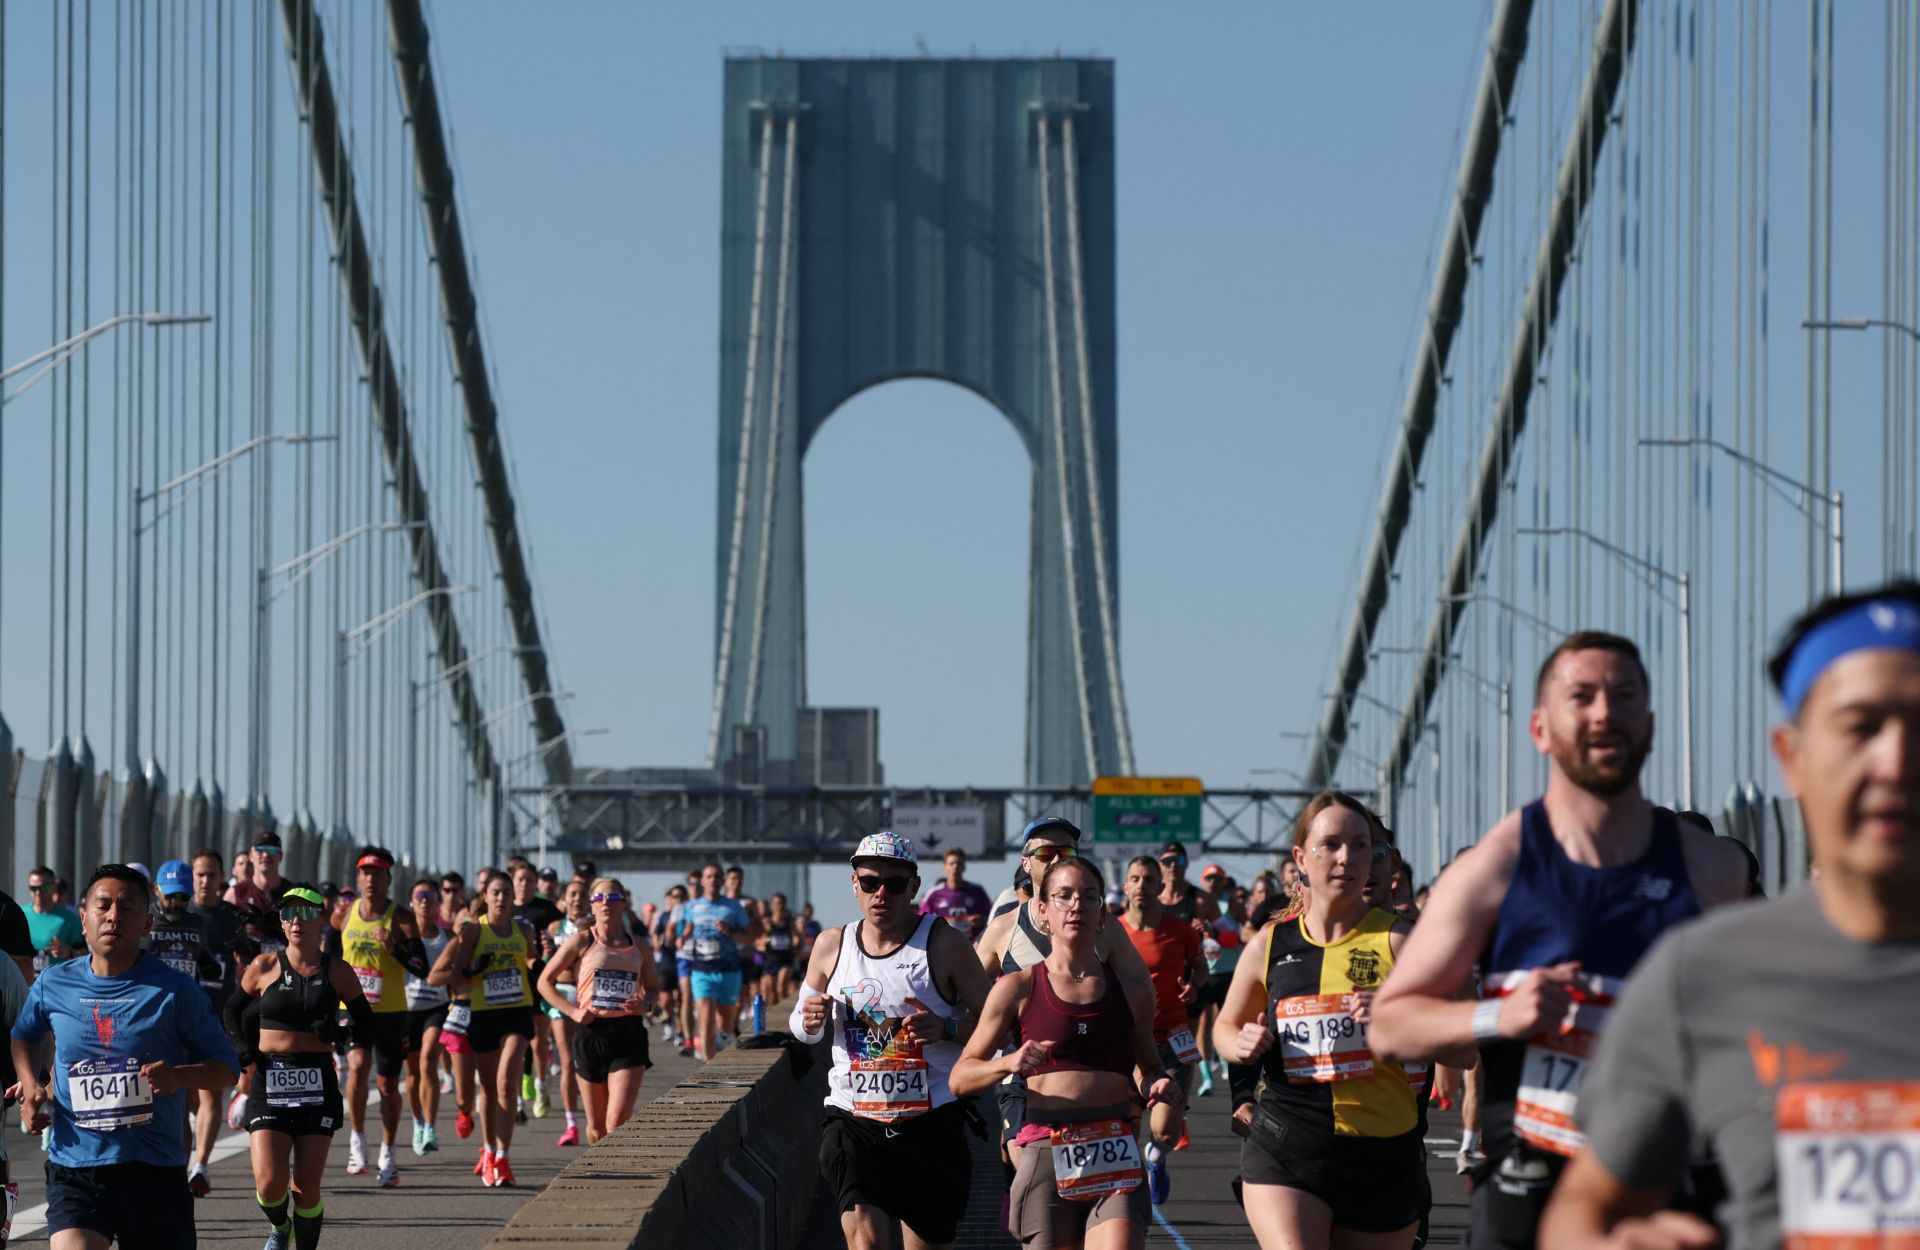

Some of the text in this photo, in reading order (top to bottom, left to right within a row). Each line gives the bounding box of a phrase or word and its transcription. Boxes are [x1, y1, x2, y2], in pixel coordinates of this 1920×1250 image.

[150, 931, 200, 943] TEAM TCS
[486, 977, 520, 992] 16264
[597, 979, 633, 995] 16540
[848, 1026, 892, 1041] TEAM
[1284, 1021, 1310, 1044] AG
[80, 1074, 139, 1101] 16411
[270, 1069, 318, 1087] 16500
[855, 1072, 923, 1094] 24054
[1061, 1138, 1132, 1170] 18782
[1805, 1142, 1912, 1204] 120
